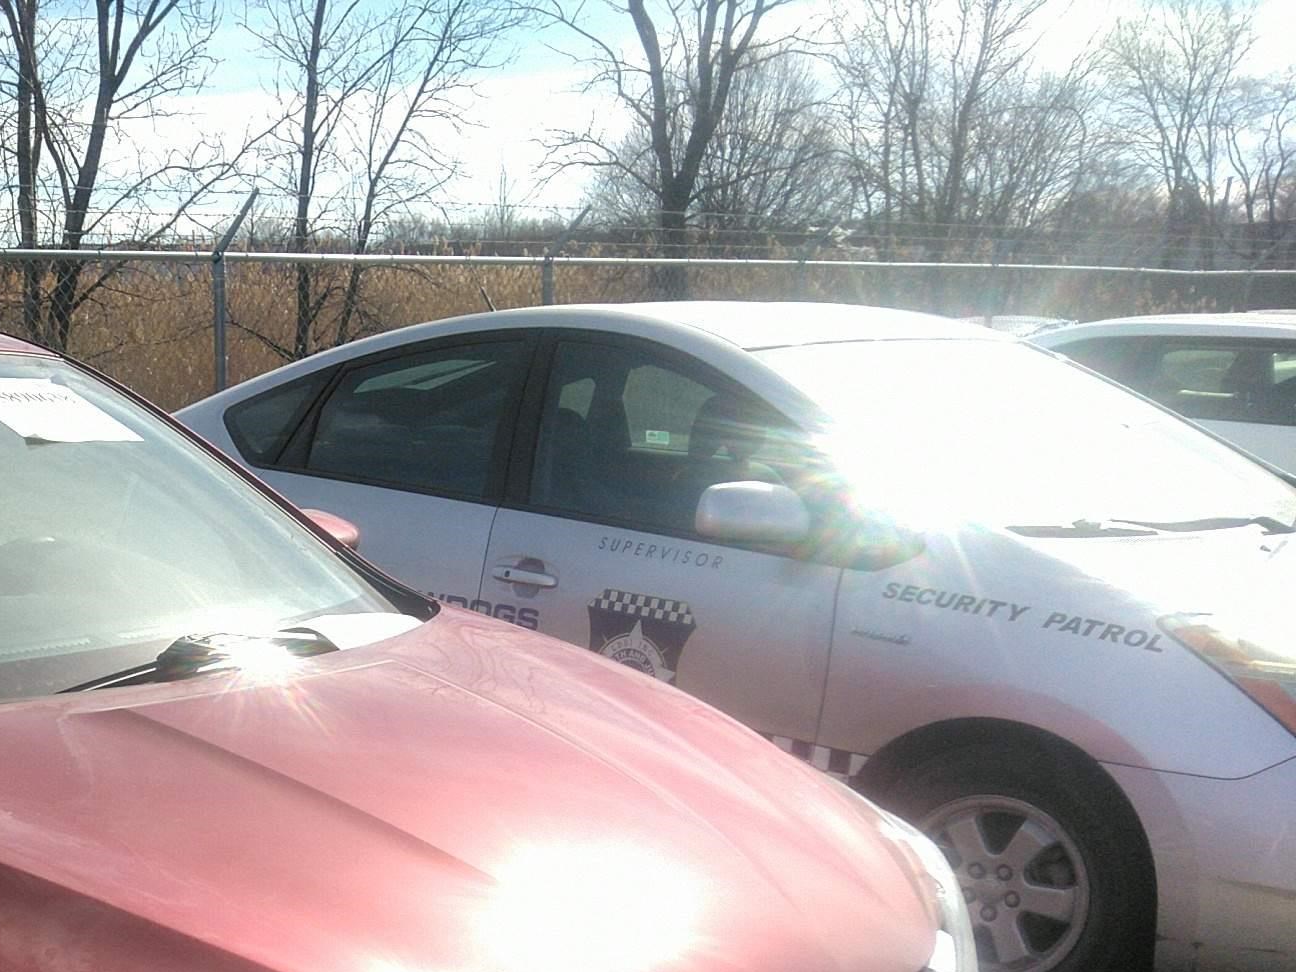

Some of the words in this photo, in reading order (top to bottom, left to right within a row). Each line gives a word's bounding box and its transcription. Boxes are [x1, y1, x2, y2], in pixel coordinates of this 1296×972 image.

[597, 536, 724, 569] SUPERVISOR
[882, 581, 1031, 622] SECURITY
[1041, 611, 1164, 653] PATROL
